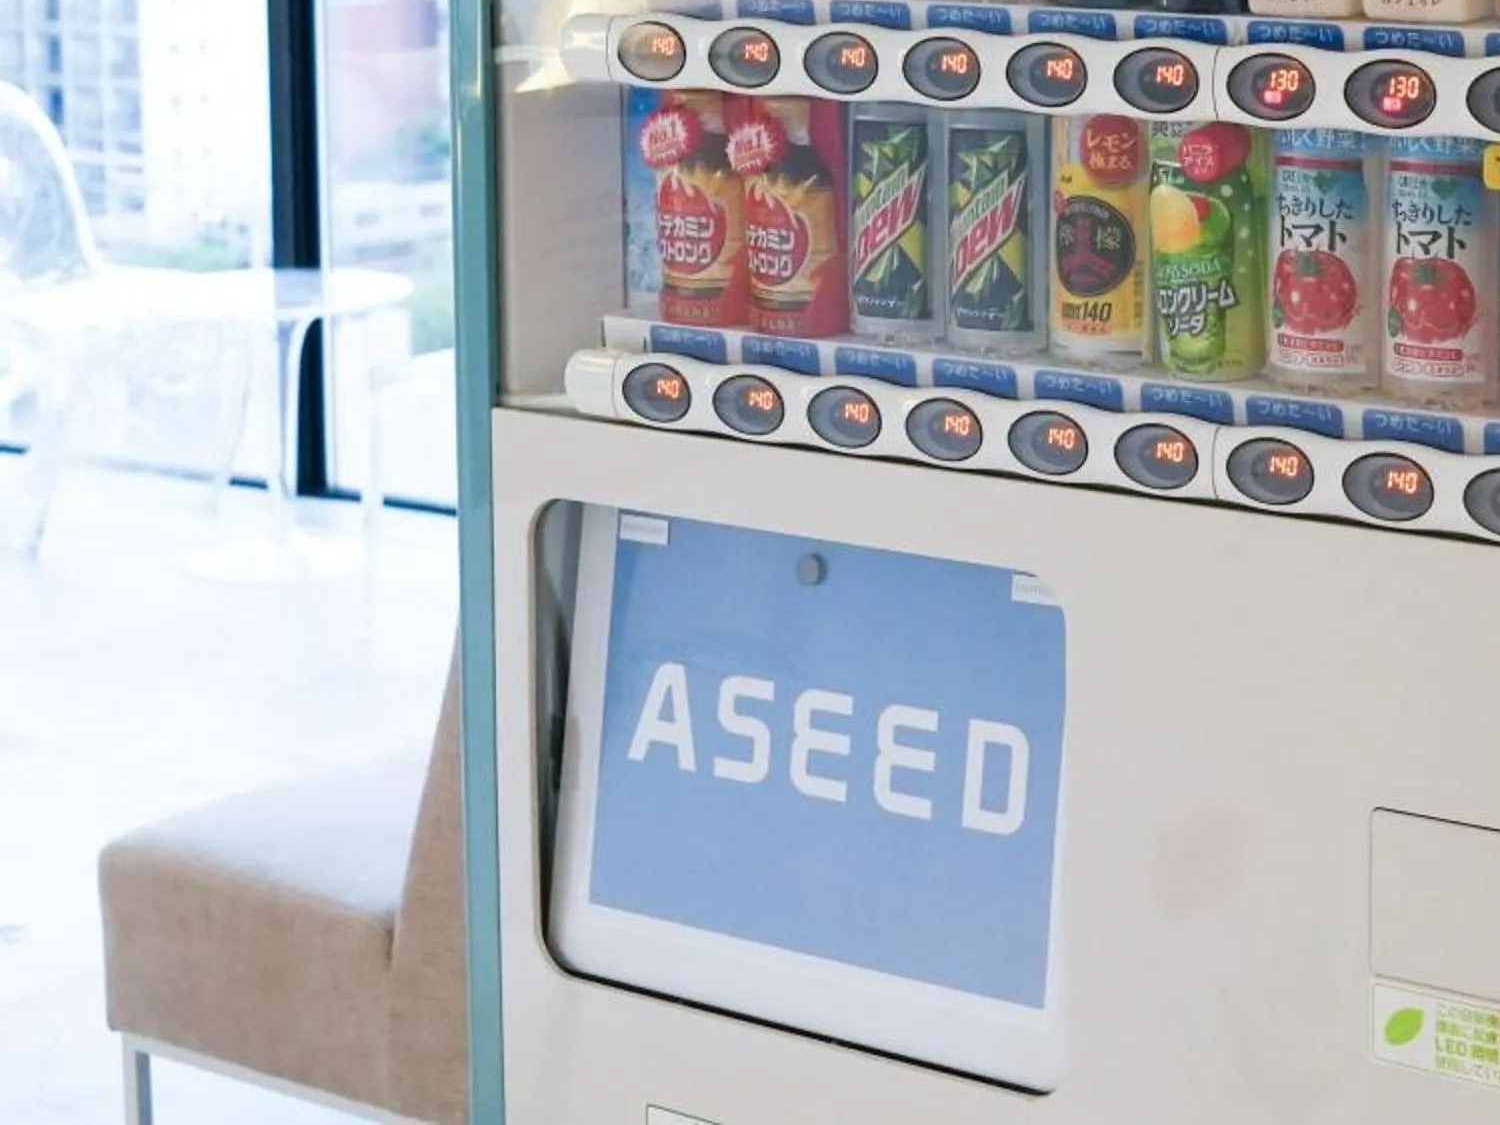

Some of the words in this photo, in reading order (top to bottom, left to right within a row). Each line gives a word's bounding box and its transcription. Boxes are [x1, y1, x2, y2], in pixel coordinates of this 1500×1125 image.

[652, 36, 675, 56] 140
[744, 43, 768, 62] 140
[841, 47, 865, 67] 140
[941, 54, 966, 73] 140
[1047, 59, 1073, 79] 140
[1156, 65, 1184, 86] 140
[1270, 70, 1298, 92] 130
[1388, 76, 1419, 98] 130
[1086, 128, 1137, 153] レモン
[1279, 216, 1347, 252] トマト
[1396, 222, 1467, 259] トマト
[657, 379, 679, 398] 140
[749, 391, 773, 410] 140
[845, 402, 869, 423] 140
[945, 416, 970, 435] 140
[1048, 428, 1075, 449] 140
[1157, 441, 1184, 462] 140
[1270, 456, 1298, 476] 140
[1388, 471, 1418, 494] 140
[628, 661, 1030, 836] ASEED
